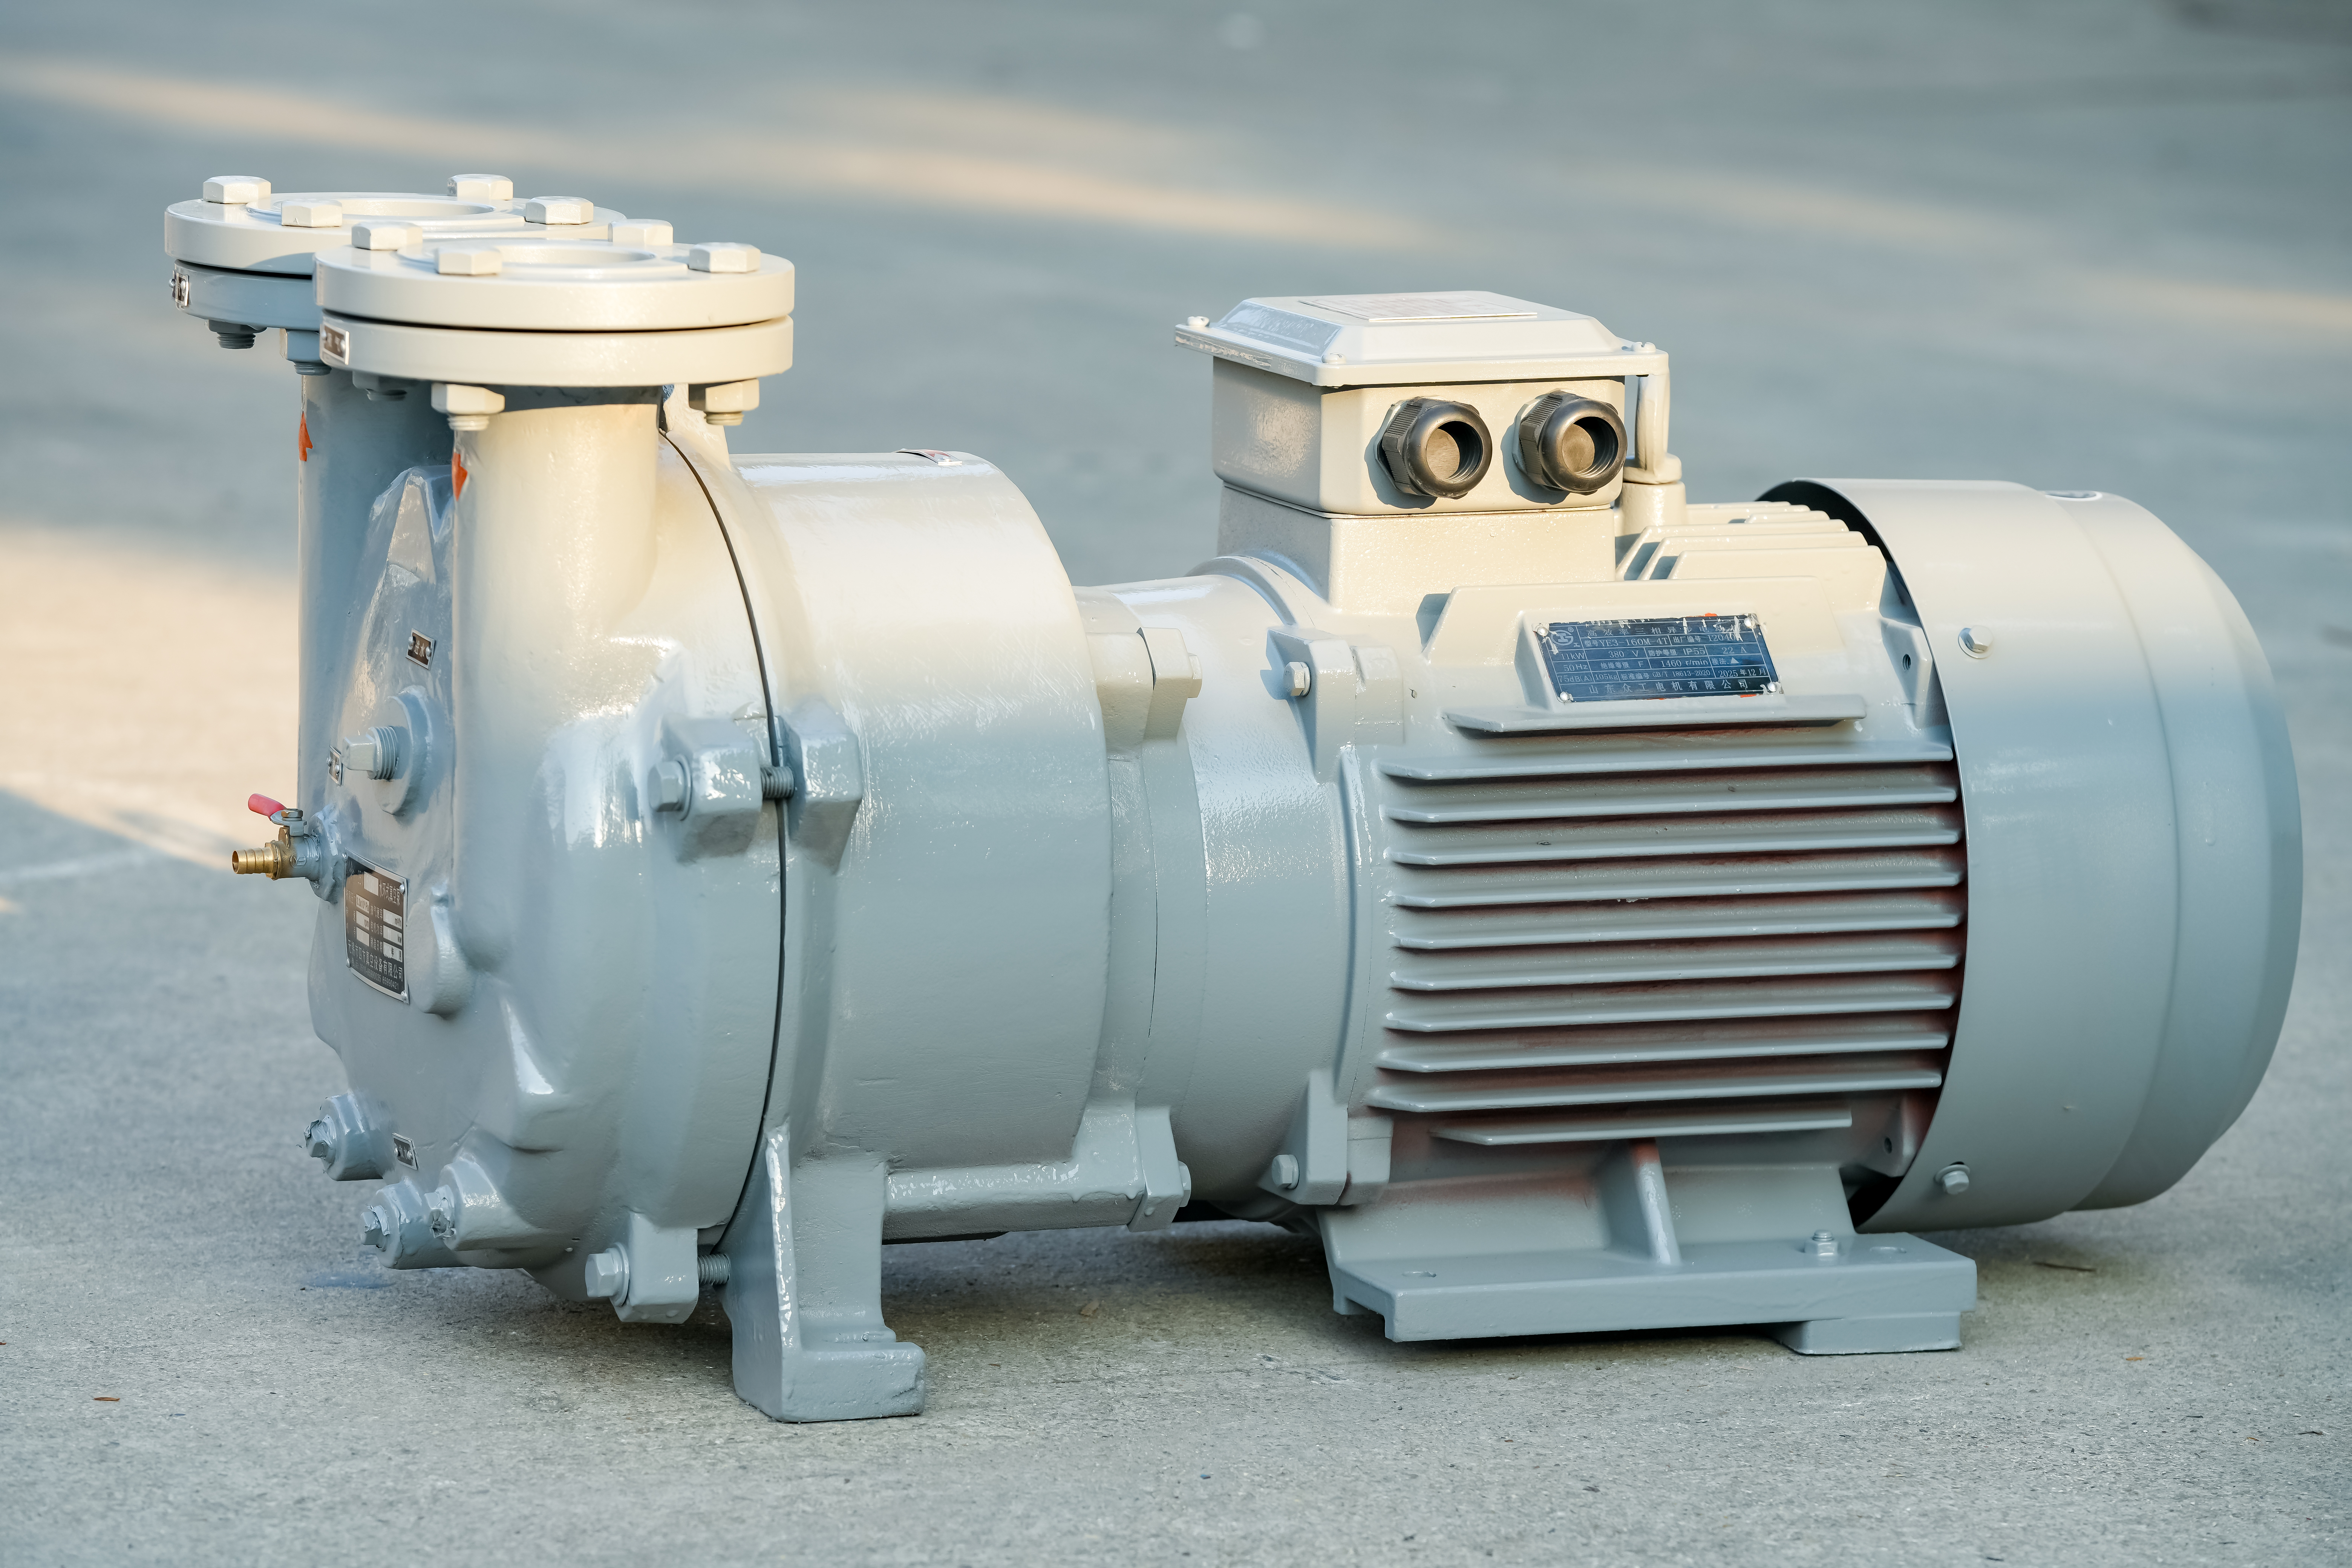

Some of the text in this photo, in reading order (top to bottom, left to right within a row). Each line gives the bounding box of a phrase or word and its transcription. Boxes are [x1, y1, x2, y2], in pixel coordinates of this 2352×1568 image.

[1599, 637, 1668, 647] YE3-160M-4T
[1557, 674, 1592, 683] 75dB(A)
[1589, 679, 1748, 694] 山东众工电机有限公司
[379, 880, 401, 906] 水环式真空泵
[348, 939, 403, 982] 无锡市四方真空设备有限公司
